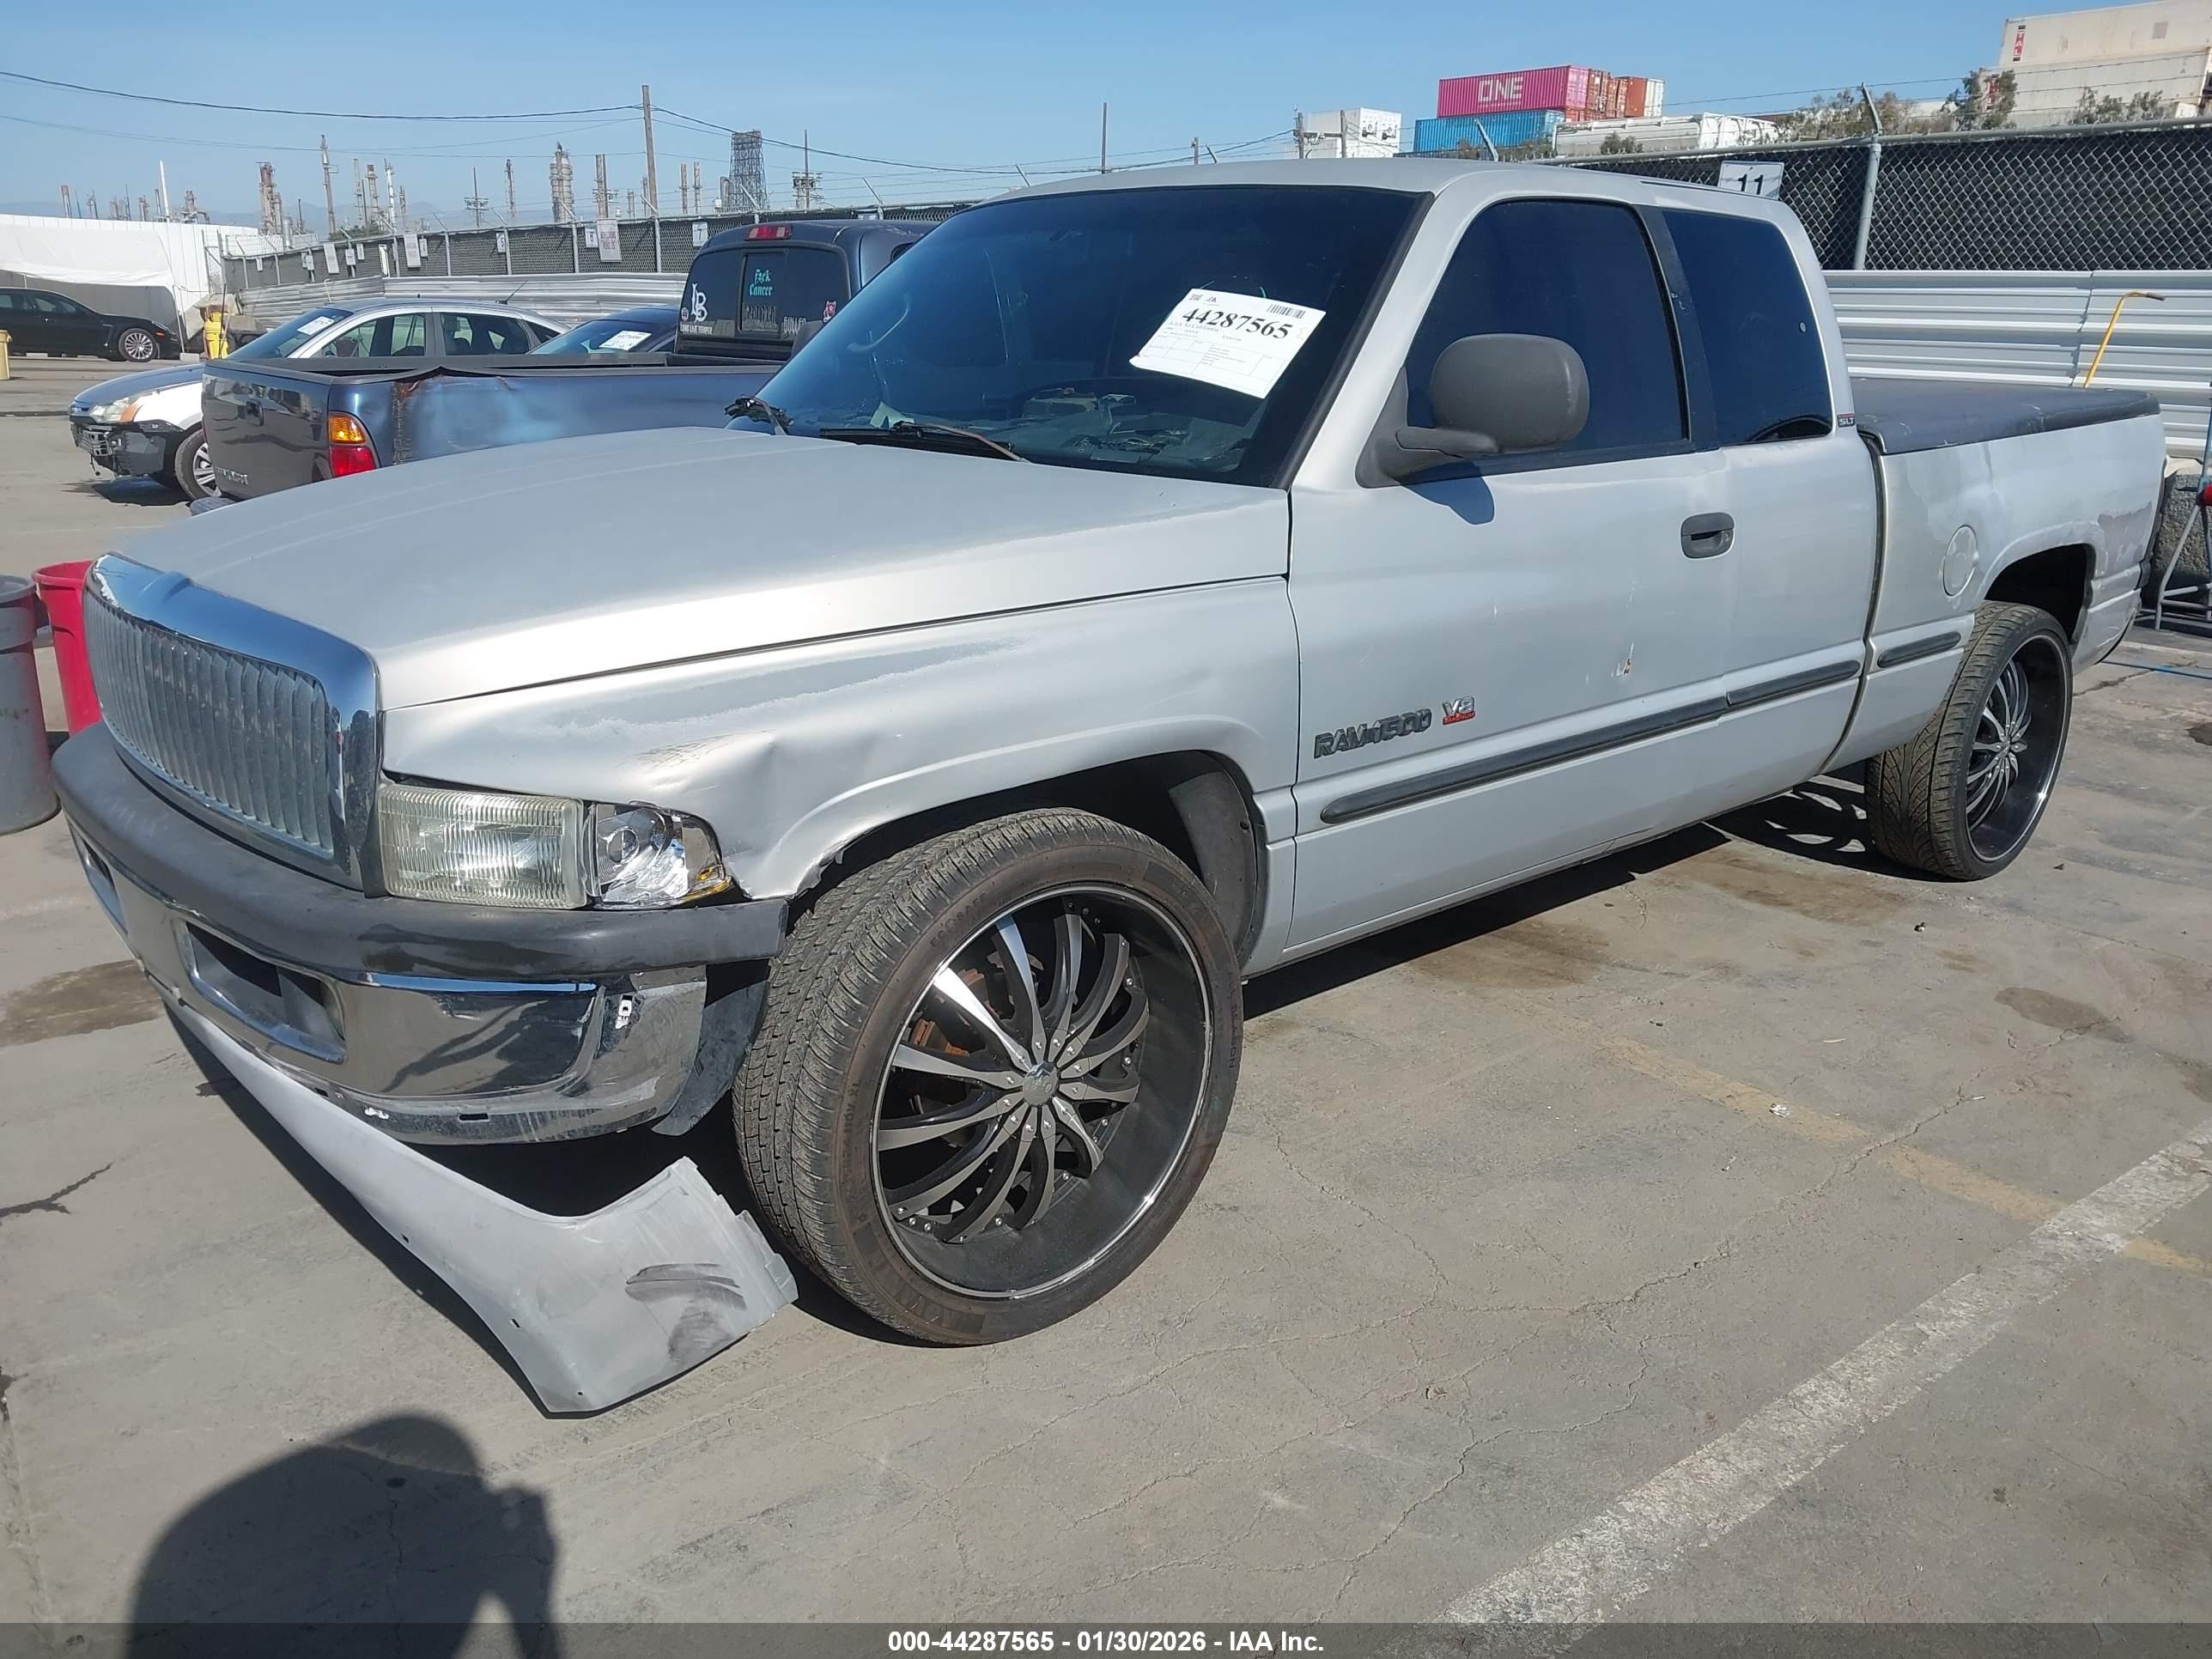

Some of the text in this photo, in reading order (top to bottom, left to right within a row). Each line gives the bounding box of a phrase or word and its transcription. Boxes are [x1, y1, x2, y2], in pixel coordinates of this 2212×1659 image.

[1478, 76, 1523, 102] ONE
[1738, 173, 1764, 195] 11
[750, 283, 773, 296] Cancer
[1182, 307, 1294, 339] 44287565
[1838, 417, 1855, 426] SLT
[1442, 696, 1475, 717] V8
[1314, 708, 1432, 759] RAM 1500
